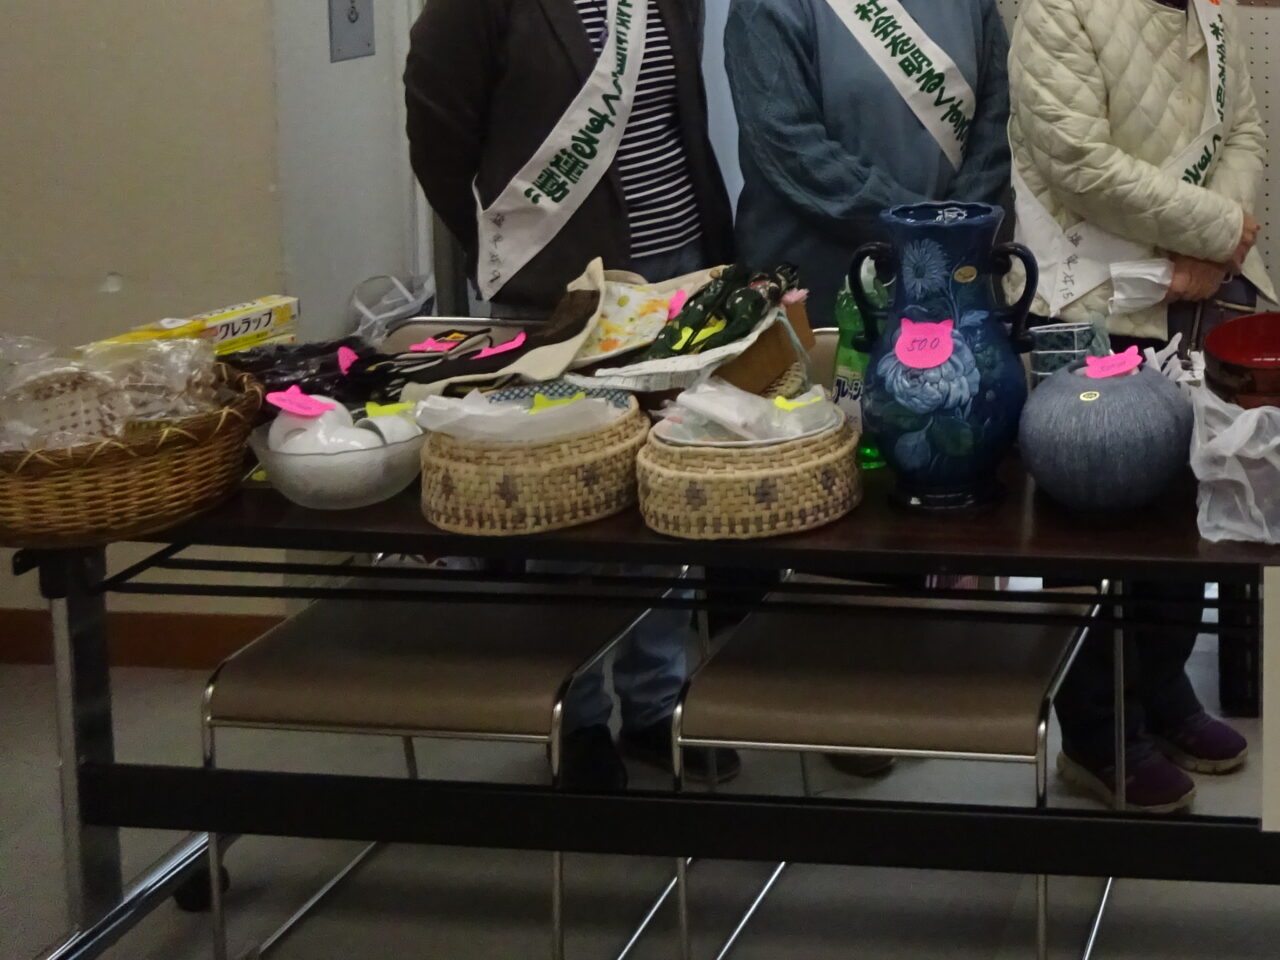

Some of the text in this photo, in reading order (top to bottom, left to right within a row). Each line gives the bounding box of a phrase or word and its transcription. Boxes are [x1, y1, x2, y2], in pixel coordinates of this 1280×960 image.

[218, 308, 273, 340] クレラップ
[906, 337, 940, 352] 500
